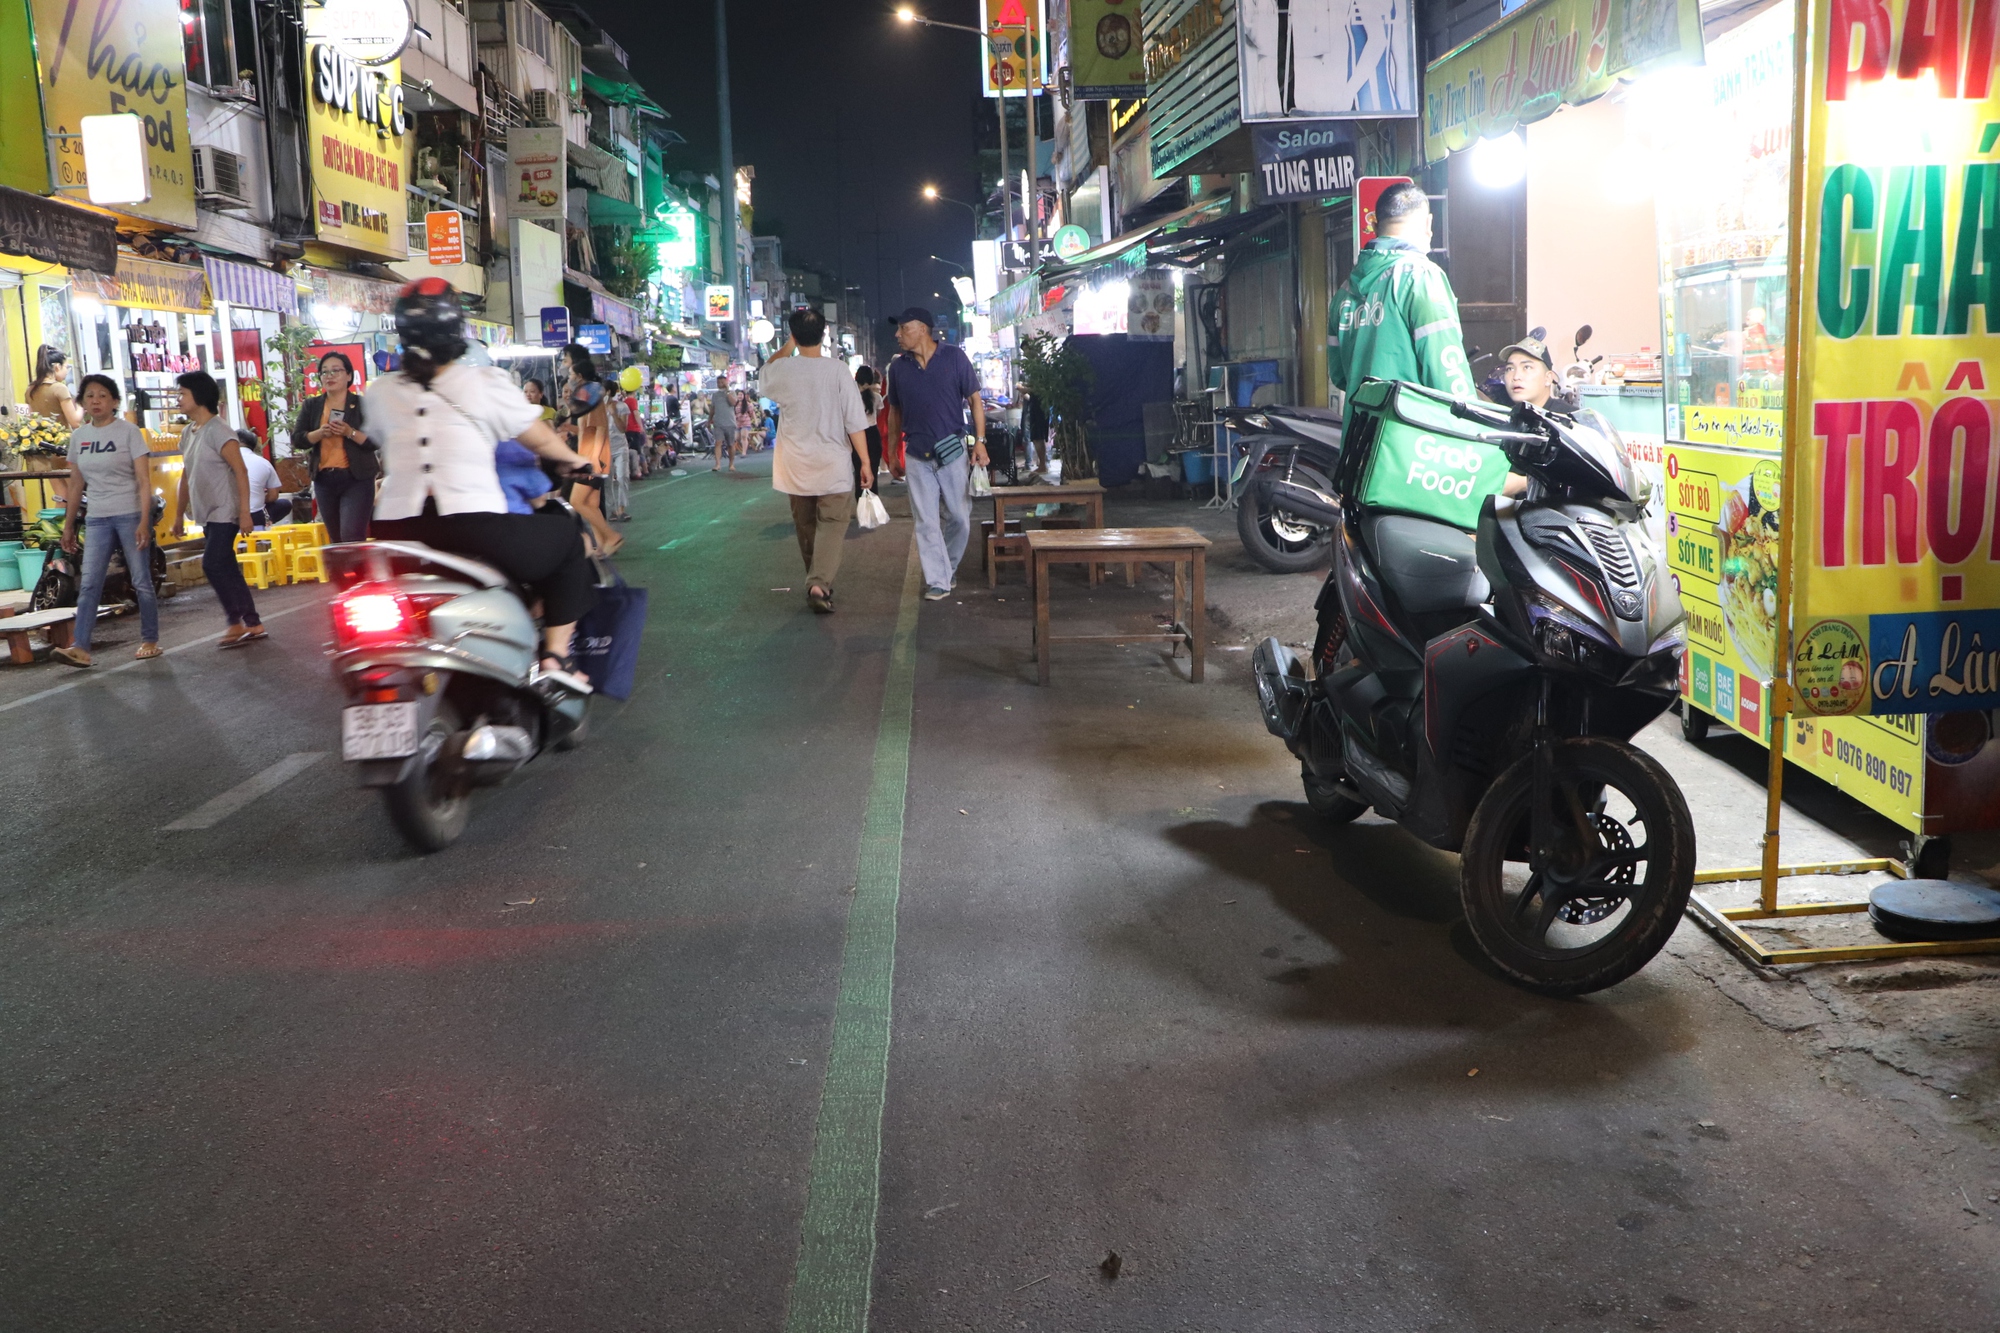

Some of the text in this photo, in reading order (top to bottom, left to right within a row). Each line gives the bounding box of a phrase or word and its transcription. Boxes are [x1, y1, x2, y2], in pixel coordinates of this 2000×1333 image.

[111, 91, 175, 152] Fod
[1277, 129, 1334, 149] Salon
[1262, 153, 1355, 196] TÙNG HAIR
[23, 242, 57, 259] Fruits
[1339, 292, 1385, 331] Grab
[237, 360, 257, 379] UA
[1440, 344, 1474, 400] Gra
[80, 440, 117, 454] FILA
[1414, 434, 1482, 474] Grab
[1643, 442, 1654, 462] GÀ
[1406, 461, 1476, 499] Food
[1678, 475, 1695, 509] SỐT
[1697, 481, 1710, 513] BÒ
[1670, 516, 1675, 532] 5
[1678, 532, 1714, 574] SỐT ME
[1703, 615, 1723, 645] RUỐC
[1797, 641, 1861, 661] A LÂM
[1873, 623, 1918, 700] A
[1695, 667, 1708, 681] Grab
[1717, 672, 1732, 693] BAE
[1695, 680, 1709, 693] Food
[1717, 689, 1733, 711] MIN
[1805, 720, 1814, 734] be
[1837, 737, 1912, 797] 0976 890 697
